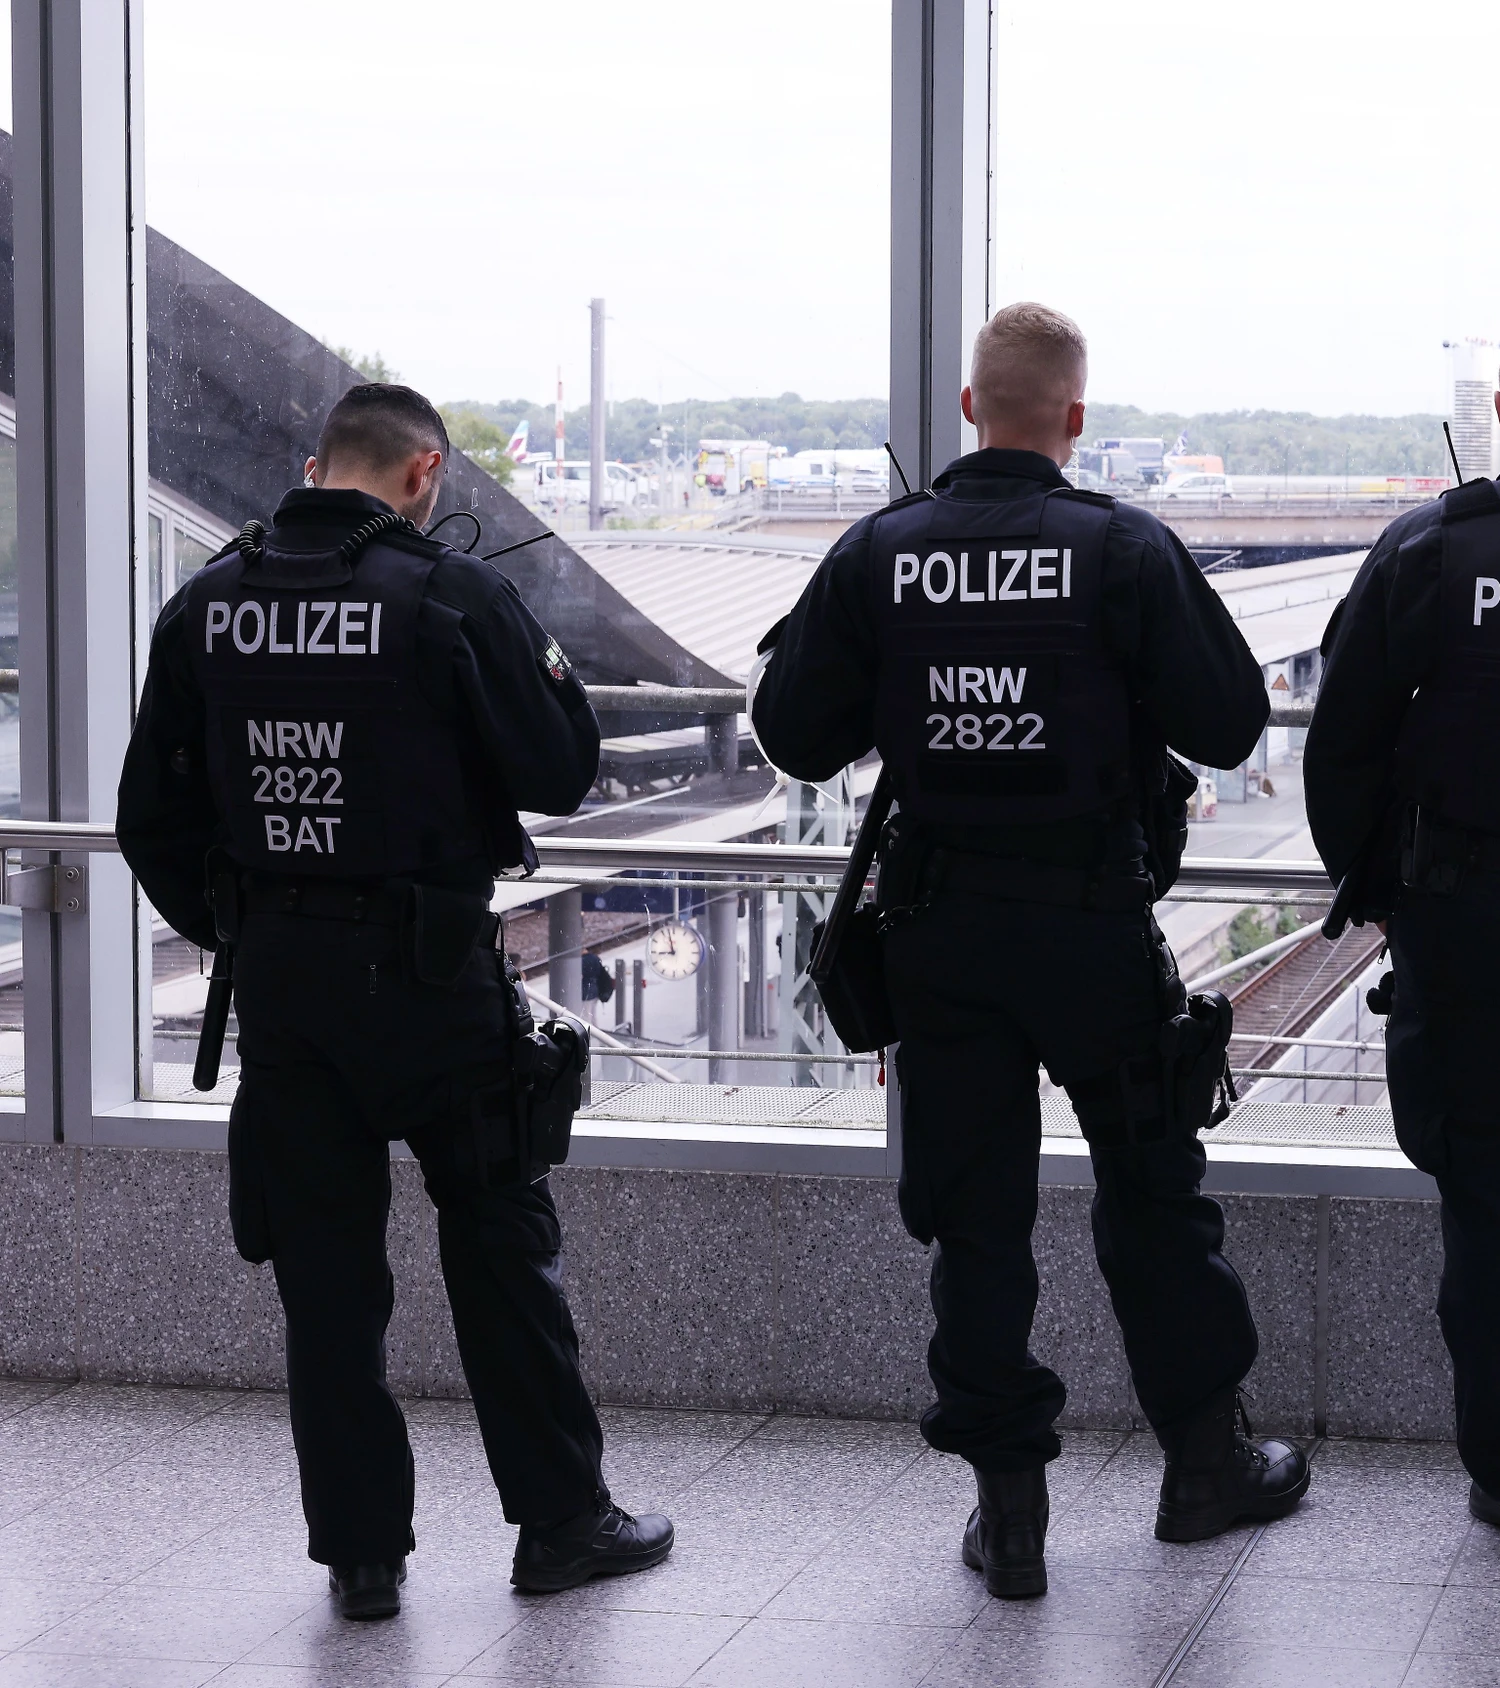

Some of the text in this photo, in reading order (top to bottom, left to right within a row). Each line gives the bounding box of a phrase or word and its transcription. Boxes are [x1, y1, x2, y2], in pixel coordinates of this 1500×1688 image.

[894, 549, 1071, 603] POLIZEI
[206, 601, 381, 654] POLIZEI
[930, 667, 1026, 703] NRW
[248, 720, 343, 758] NRW
[927, 713, 1045, 749] 2822
[252, 766, 343, 804] 2822
[265, 816, 341, 853] BAT
